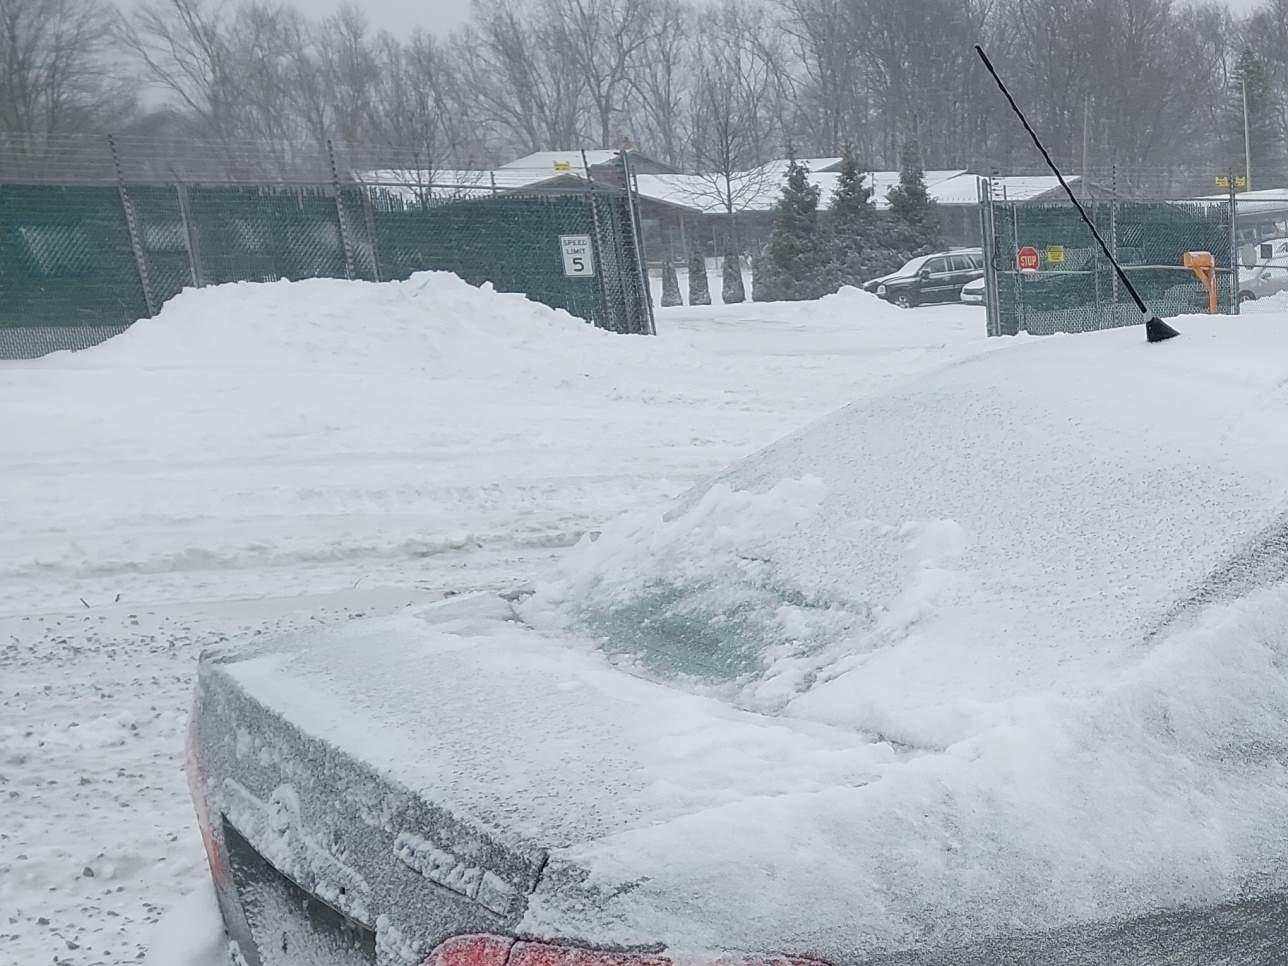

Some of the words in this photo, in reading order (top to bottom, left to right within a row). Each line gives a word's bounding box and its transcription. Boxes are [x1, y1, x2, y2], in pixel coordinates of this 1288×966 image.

[566, 247, 586, 255] LIMIT
[572, 257, 585, 272] 5
[1020, 255, 1037, 267] STOP
